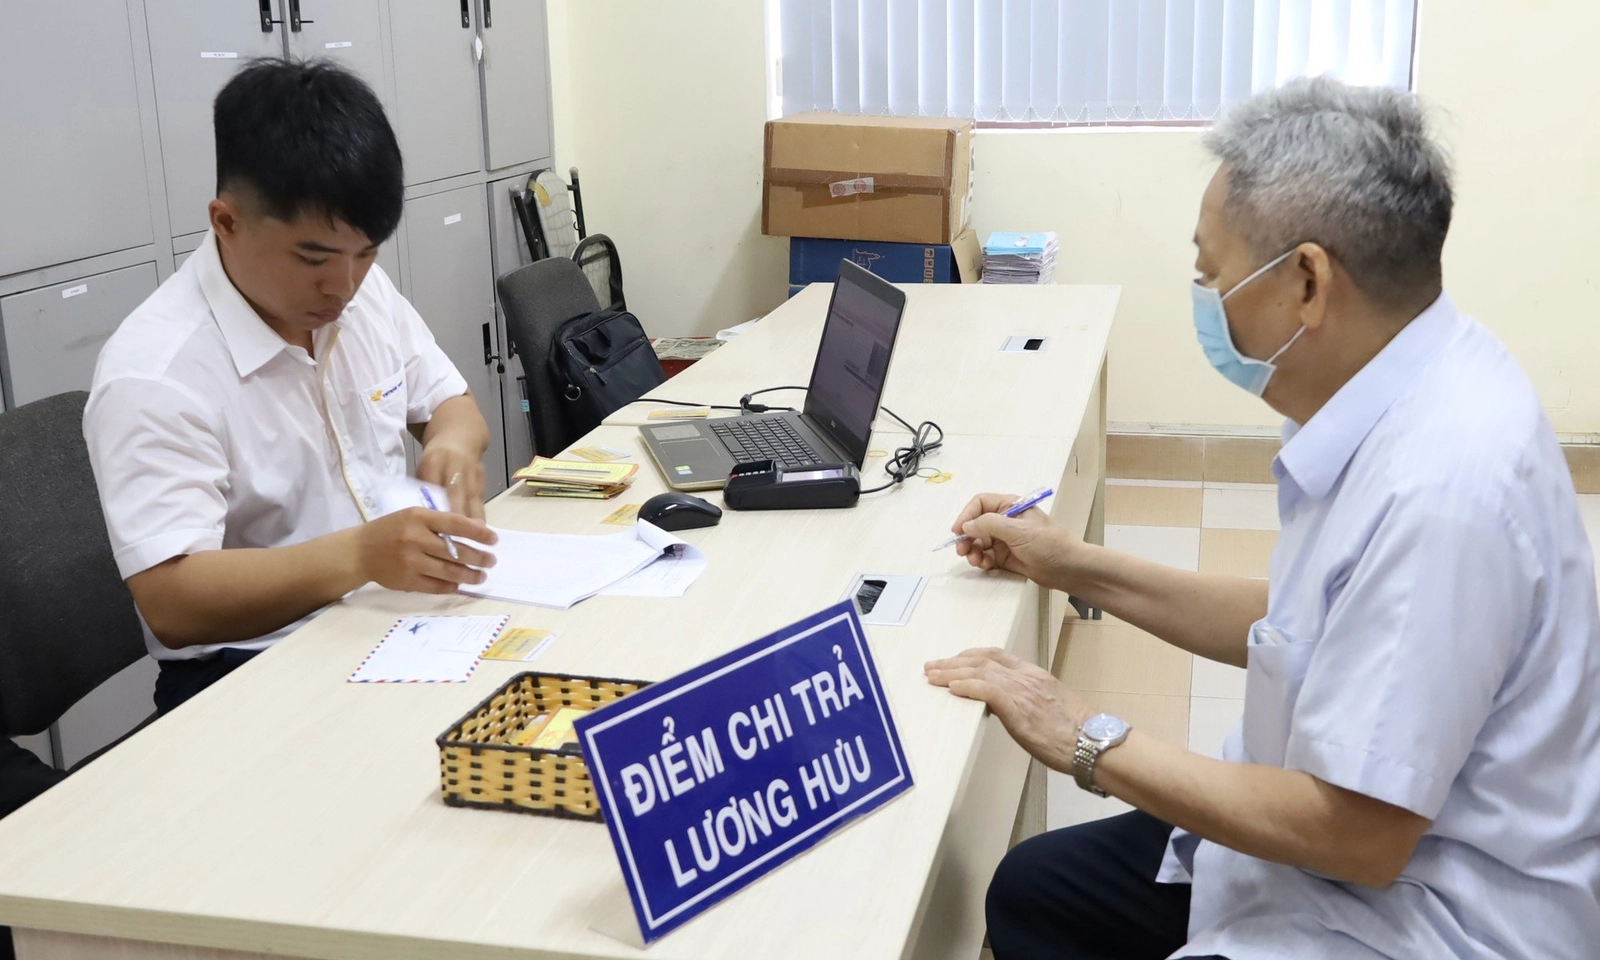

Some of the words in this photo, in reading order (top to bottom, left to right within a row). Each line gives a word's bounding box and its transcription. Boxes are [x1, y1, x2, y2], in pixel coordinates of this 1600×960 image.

[620, 716, 725, 817] ĐIỂM
[727, 693, 794, 761] CHI
[790, 644, 865, 726] TRẢ
[664, 778, 799, 888] LƯƠNG
[798, 735, 871, 810] HƯU
